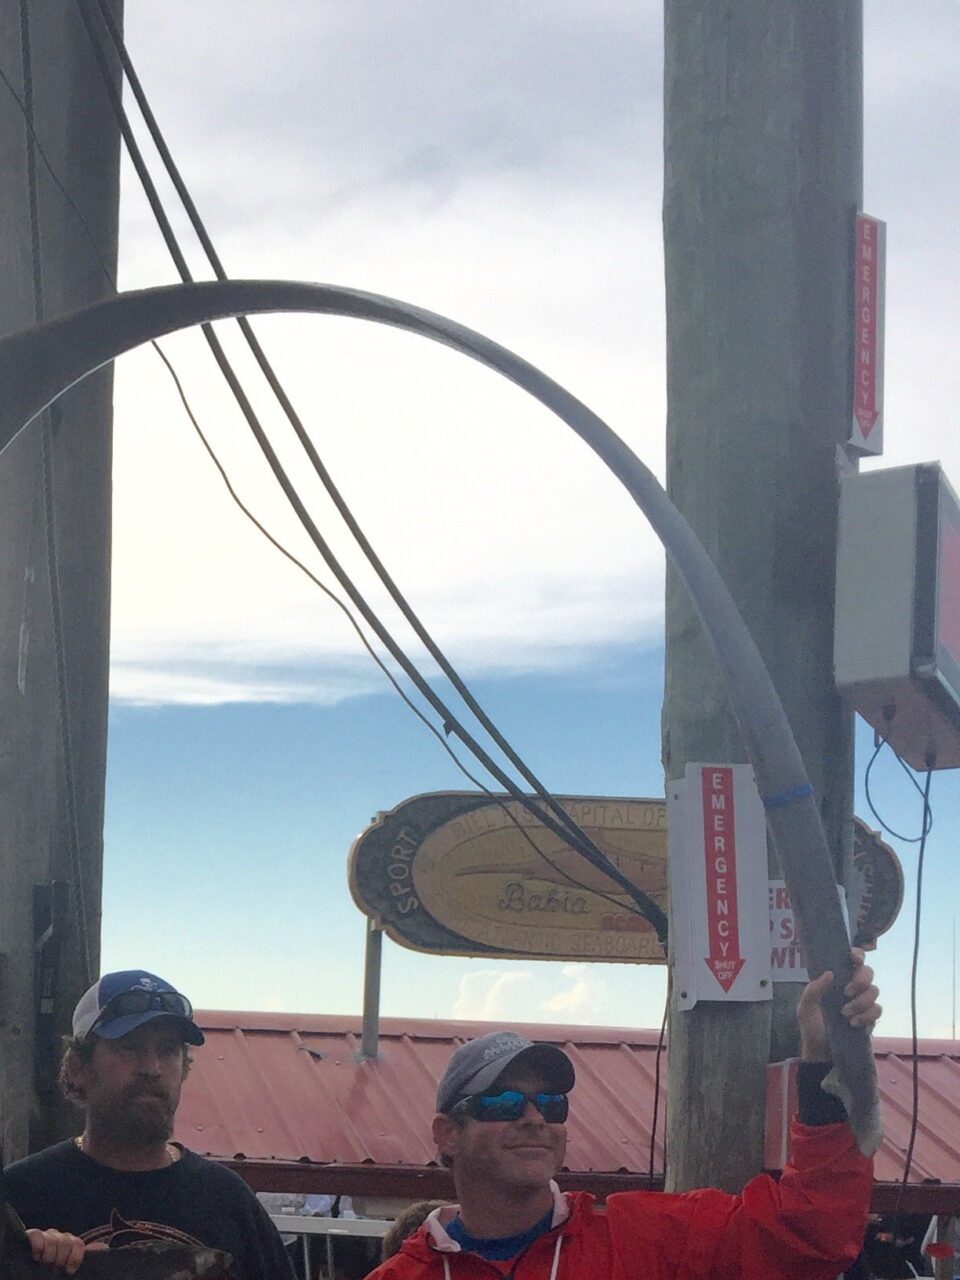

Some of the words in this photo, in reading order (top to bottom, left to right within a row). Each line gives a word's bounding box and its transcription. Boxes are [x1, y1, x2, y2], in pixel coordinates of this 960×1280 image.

[862, 223, 872, 406] EMERGENCY
[388, 827, 420, 915] SPORT
[711, 772, 730, 957] EMERGENCY
[714, 959, 737, 970] SHUT
[717, 971, 733, 981] OFF
